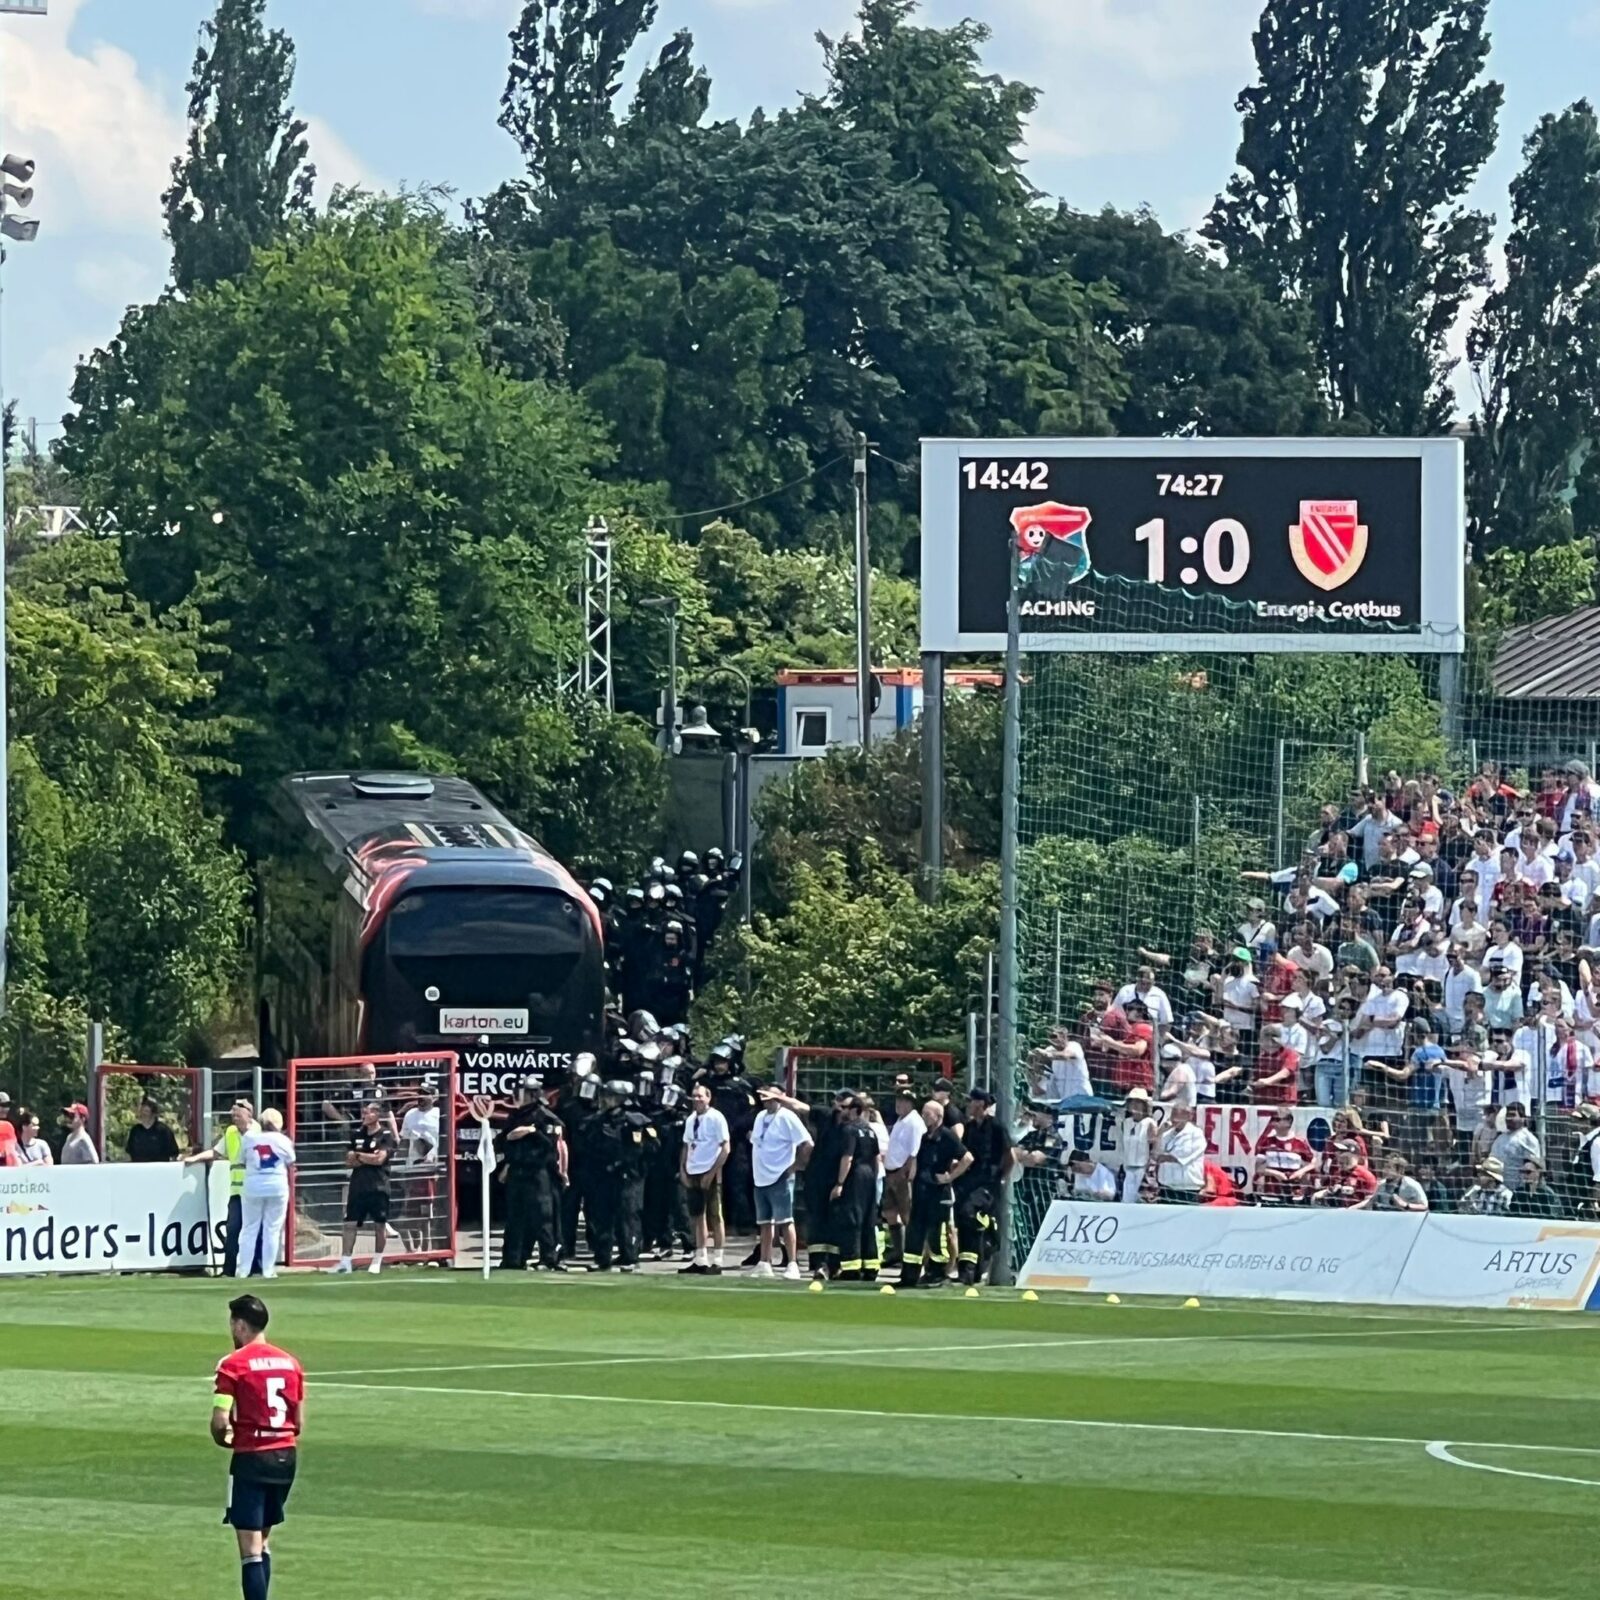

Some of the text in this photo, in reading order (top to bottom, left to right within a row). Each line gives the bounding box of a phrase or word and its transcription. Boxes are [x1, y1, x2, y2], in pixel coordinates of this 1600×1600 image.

[962, 461, 1049, 490] 14:42
[1156, 474, 1224, 496] 74:27
[1135, 517, 1251, 585] 1:0
[1006, 600, 1096, 616] ACHING
[1328, 600, 1402, 619] Cottbus
[444, 1013, 524, 1029] karton.eu
[464, 1049, 572, 1068] VORWÄRTS
[1045, 1214, 1119, 1244] AKO
[1037, 1249, 1222, 1270] VERSICHERUNGSMAKLER
[1225, 1253, 1275, 1271] GMBH
[1274, 1255, 1286, 1271] &
[1317, 1257, 1341, 1274] KG
[1483, 1249, 1578, 1275] ARTUS
[266, 1377, 288, 1428] 5
